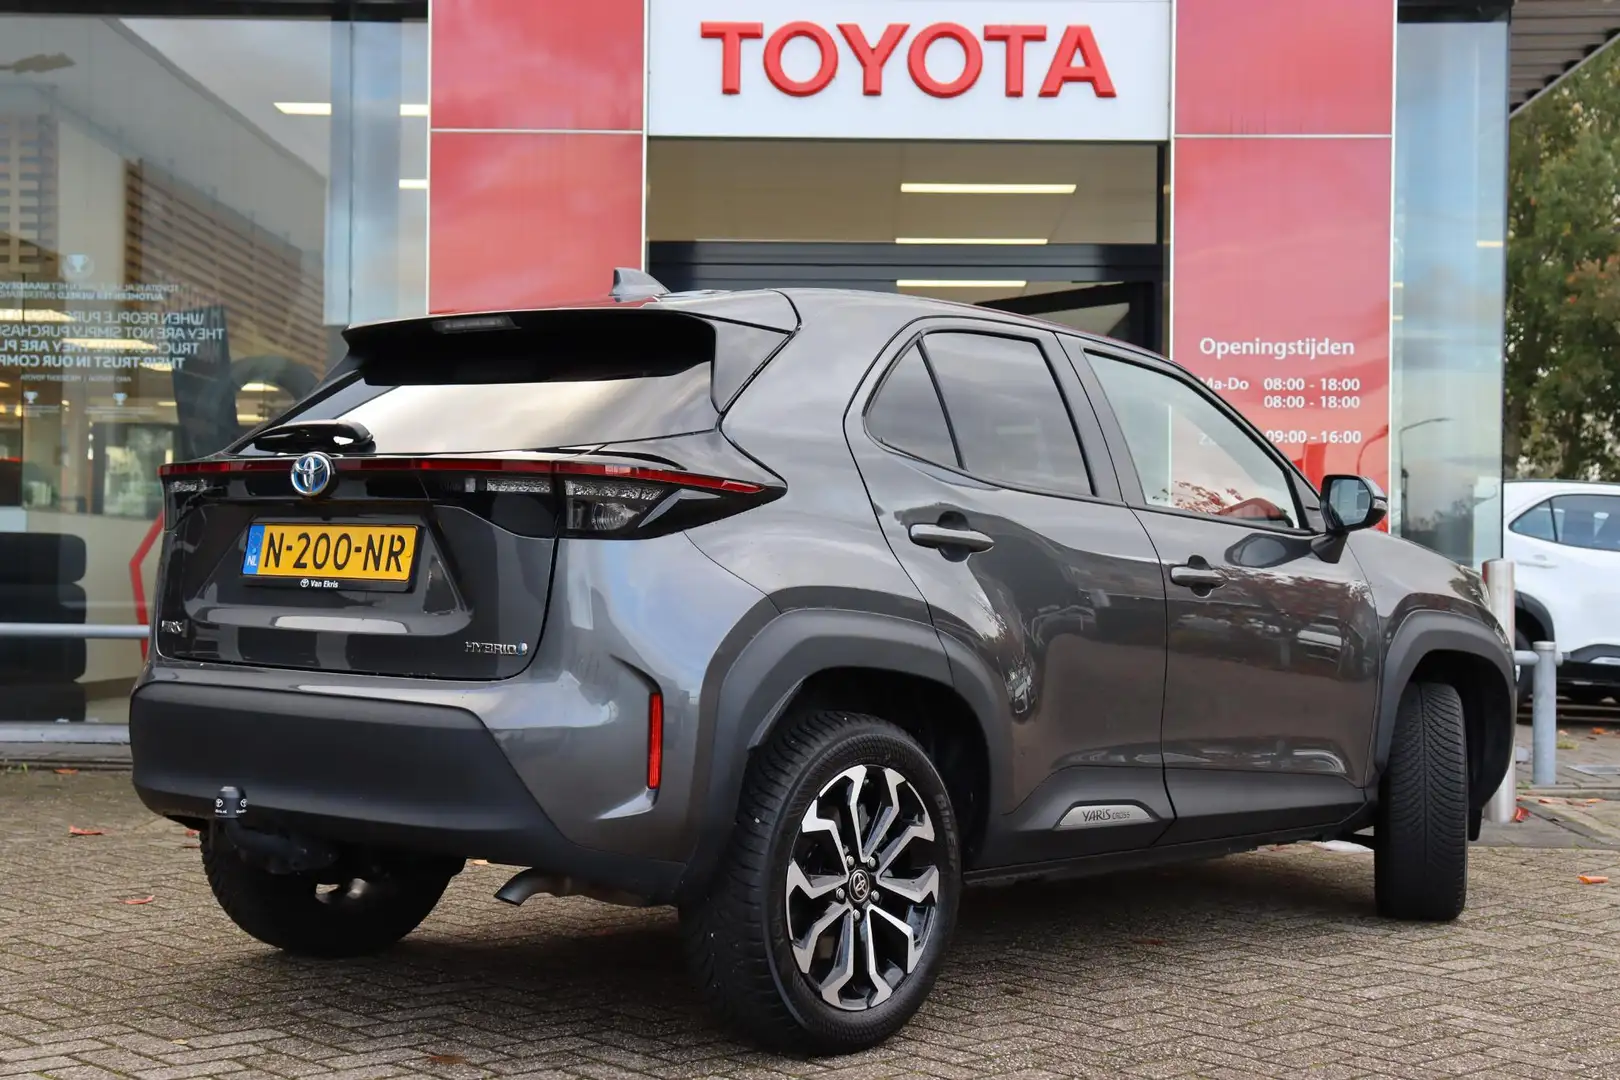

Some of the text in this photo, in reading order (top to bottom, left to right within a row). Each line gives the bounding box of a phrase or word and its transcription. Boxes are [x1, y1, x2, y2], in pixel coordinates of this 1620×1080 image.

[700, 22, 1117, 98] TOYOTA
[1199, 337, 1355, 360] Openingstijden
[1263, 377, 1305, 391] 08:00
[1320, 377, 1360, 391] 18:00
[1263, 395, 1305, 409] 08:00
[1320, 395, 1360, 409] 18:00
[1265, 430, 1307, 444] 09:00
[1321, 430, 1361, 444] 16:00
[246, 532, 406, 573] NL N-200-NR
[310, 580, 339, 588] Van Ekris
[464, 641, 517, 655] HYBRID
